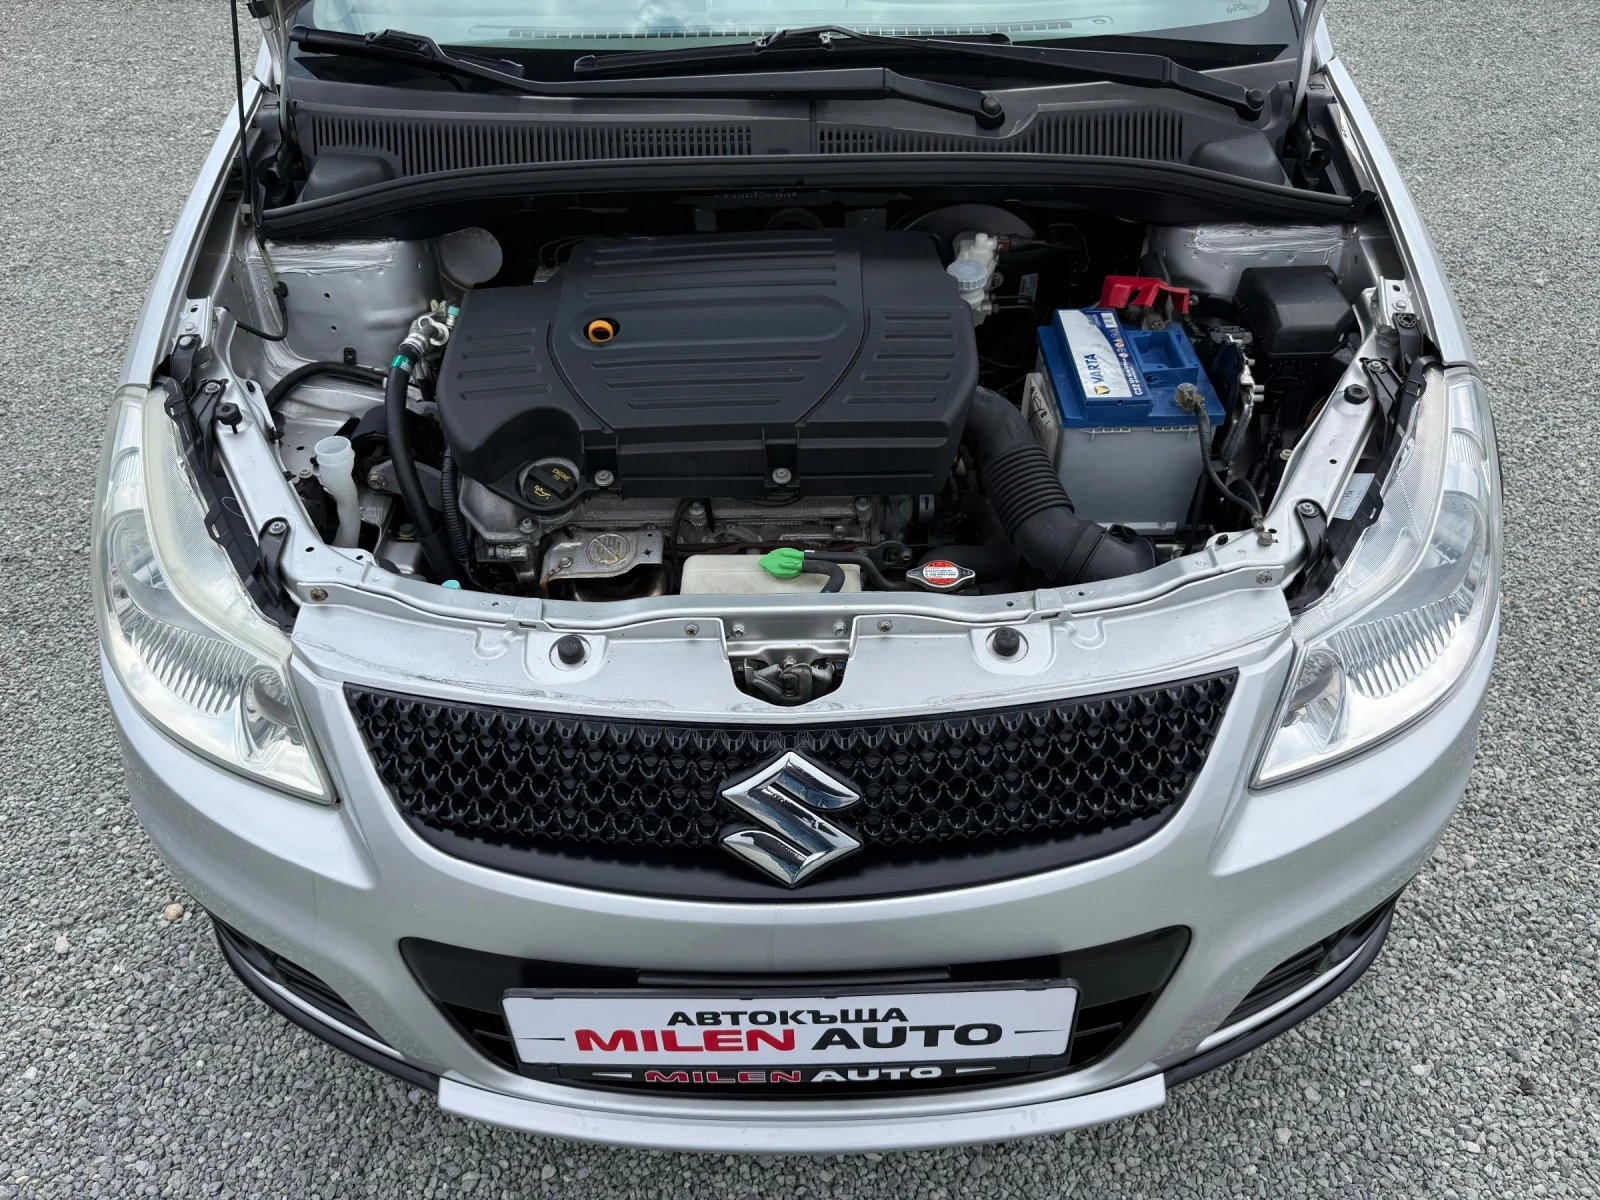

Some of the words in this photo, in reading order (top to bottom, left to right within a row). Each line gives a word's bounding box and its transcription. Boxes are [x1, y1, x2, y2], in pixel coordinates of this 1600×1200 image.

[1084, 353, 1104, 384] VARTA
[1132, 384, 1143, 396] C22
[574, 1028, 795, 1052] MILEN
[811, 1023, 1003, 1051] AUTO
[644, 1070, 801, 1083] MILEN
[811, 1067, 942, 1082] AUTO
